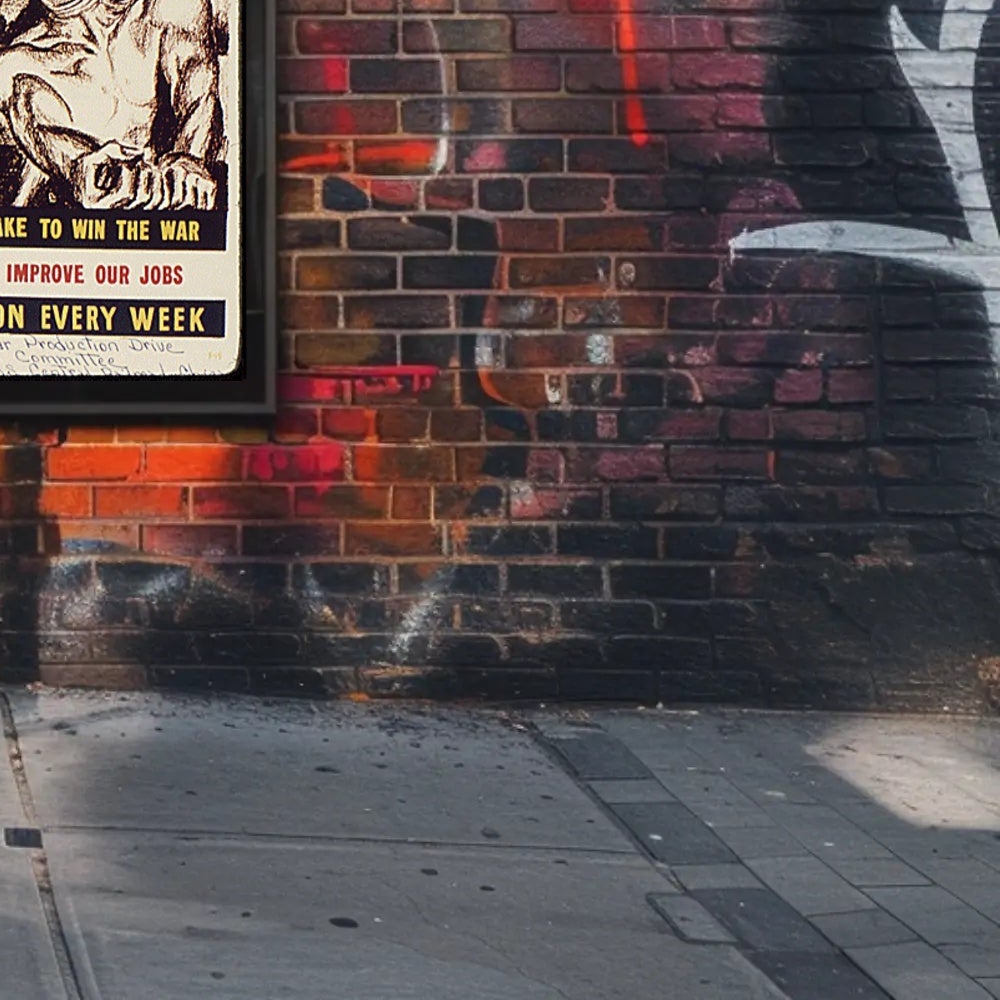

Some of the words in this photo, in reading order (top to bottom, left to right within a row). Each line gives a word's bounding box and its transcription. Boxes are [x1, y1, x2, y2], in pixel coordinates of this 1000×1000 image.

[40, 218, 62, 239] TO
[72, 219, 106, 240] WIN
[116, 220, 149, 241] THE
[160, 220, 200, 241] WAR
[7, 264, 84, 284] IMPROVE
[95, 265, 130, 284] OUR
[139, 266, 183, 285] JOBS
[41, 305, 117, 331] EVERY
[129, 307, 205, 332] WEEK
[24, 336, 120, 352] Production
[129, 338, 185, 354] Drive
[15, 350, 128, 370] Committee
